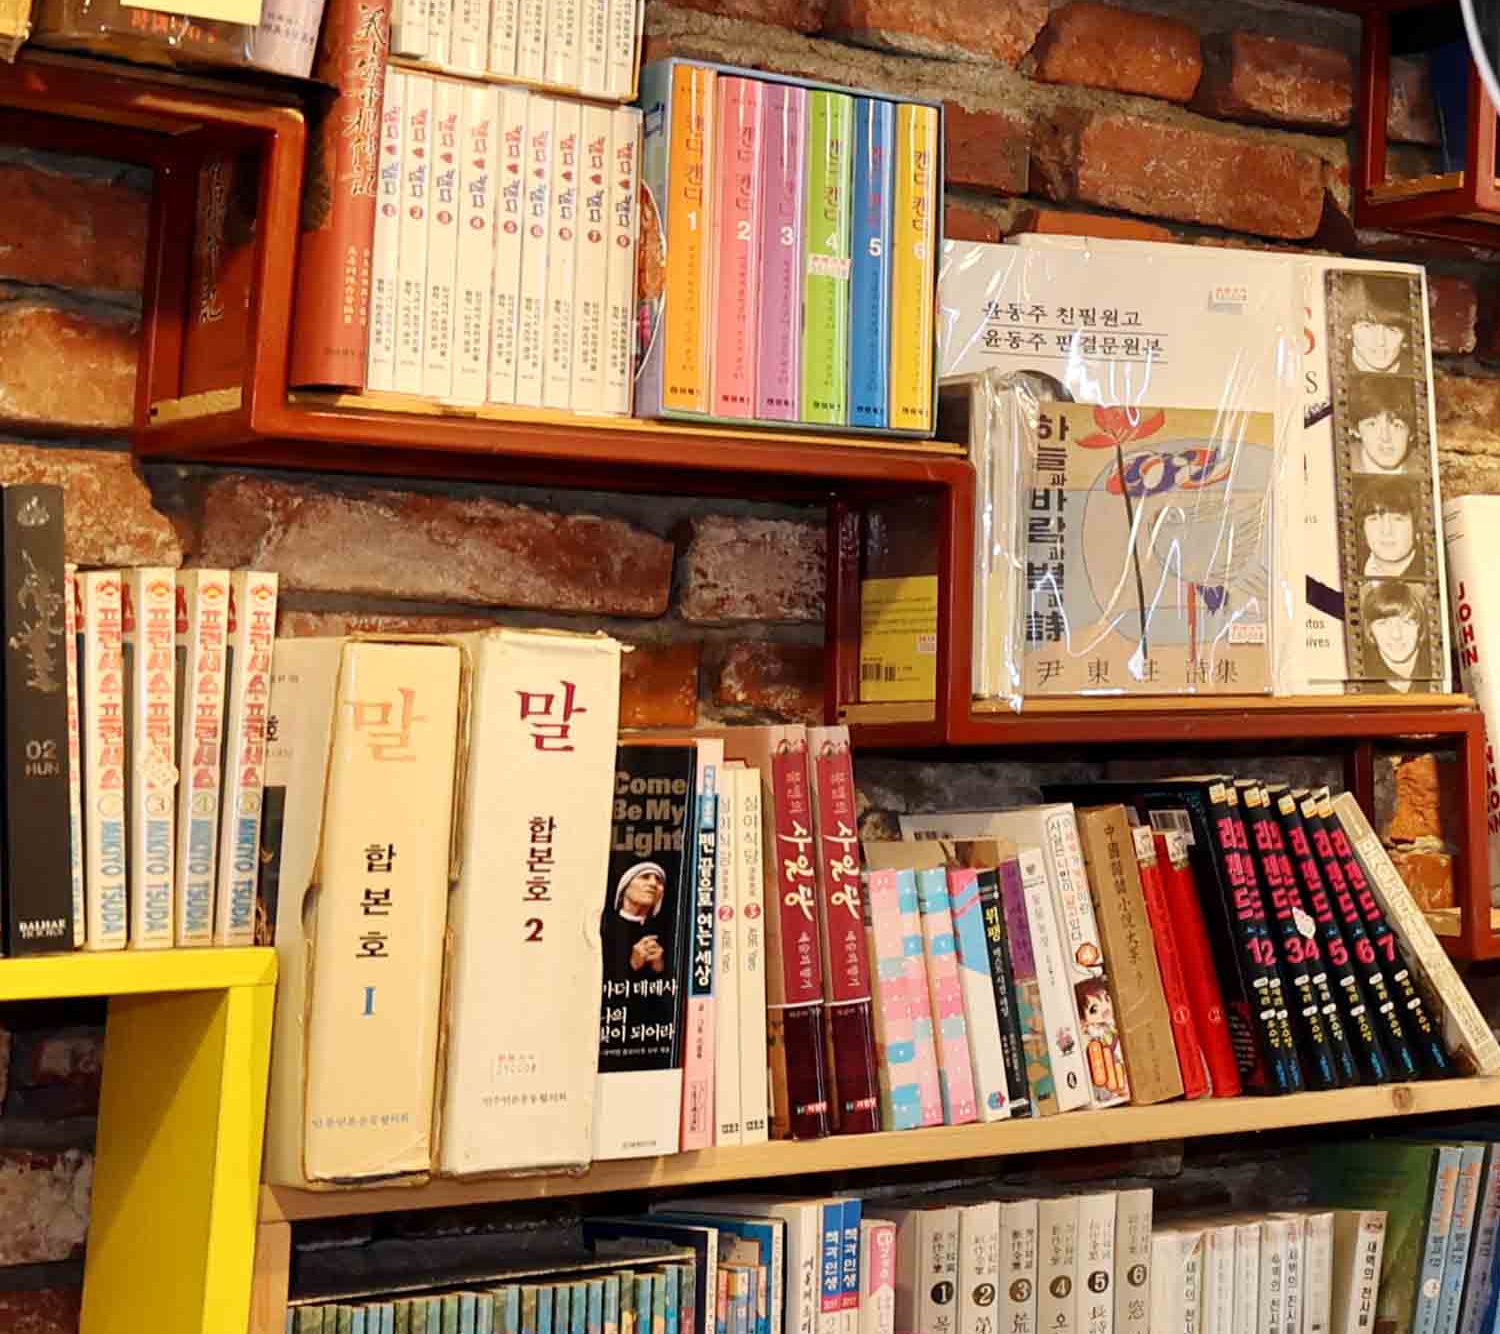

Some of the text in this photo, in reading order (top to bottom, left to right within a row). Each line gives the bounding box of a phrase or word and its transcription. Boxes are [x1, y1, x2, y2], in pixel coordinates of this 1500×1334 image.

[687, 212, 698, 231] 1
[736, 220, 752, 241] 2
[780, 226, 795, 246] 3
[868, 237, 882, 257] 5
[1055, 306, 1143, 329] 친필원고
[981, 330, 1048, 351] 윤동주
[1035, 414, 1069, 487] 하늘과
[1457, 581, 1479, 668] JOHN
[344, 685, 429, 764] 말
[514, 679, 590, 755] 말
[25, 740, 57, 762] 02
[612, 769, 688, 799] Come
[611, 800, 687, 829] Be My
[610, 825, 687, 858] Light
[521, 814, 558, 943] 합본호 2
[779, 819, 816, 922] 사임당
[823, 819, 861, 922] 사임당
[354, 841, 397, 961] 합본호
[1247, 937, 1262, 964] 1
[1261, 939, 1277, 966] 2
[1284, 937, 1304, 964] 3
[1302, 938, 1321, 963] 4
[1327, 938, 1349, 966] 5
[1355, 937, 1376, 964] 6
[1377, 932, 1396, 962] 7
[1049, 1274, 1073, 1299] 4
[1087, 1270, 1110, 1294] 5
[1127, 1264, 1147, 1287] 6
[930, 1280, 955, 1306] 1
[971, 1282, 996, 1307] 2
[1009, 1277, 1033, 1303] 3
